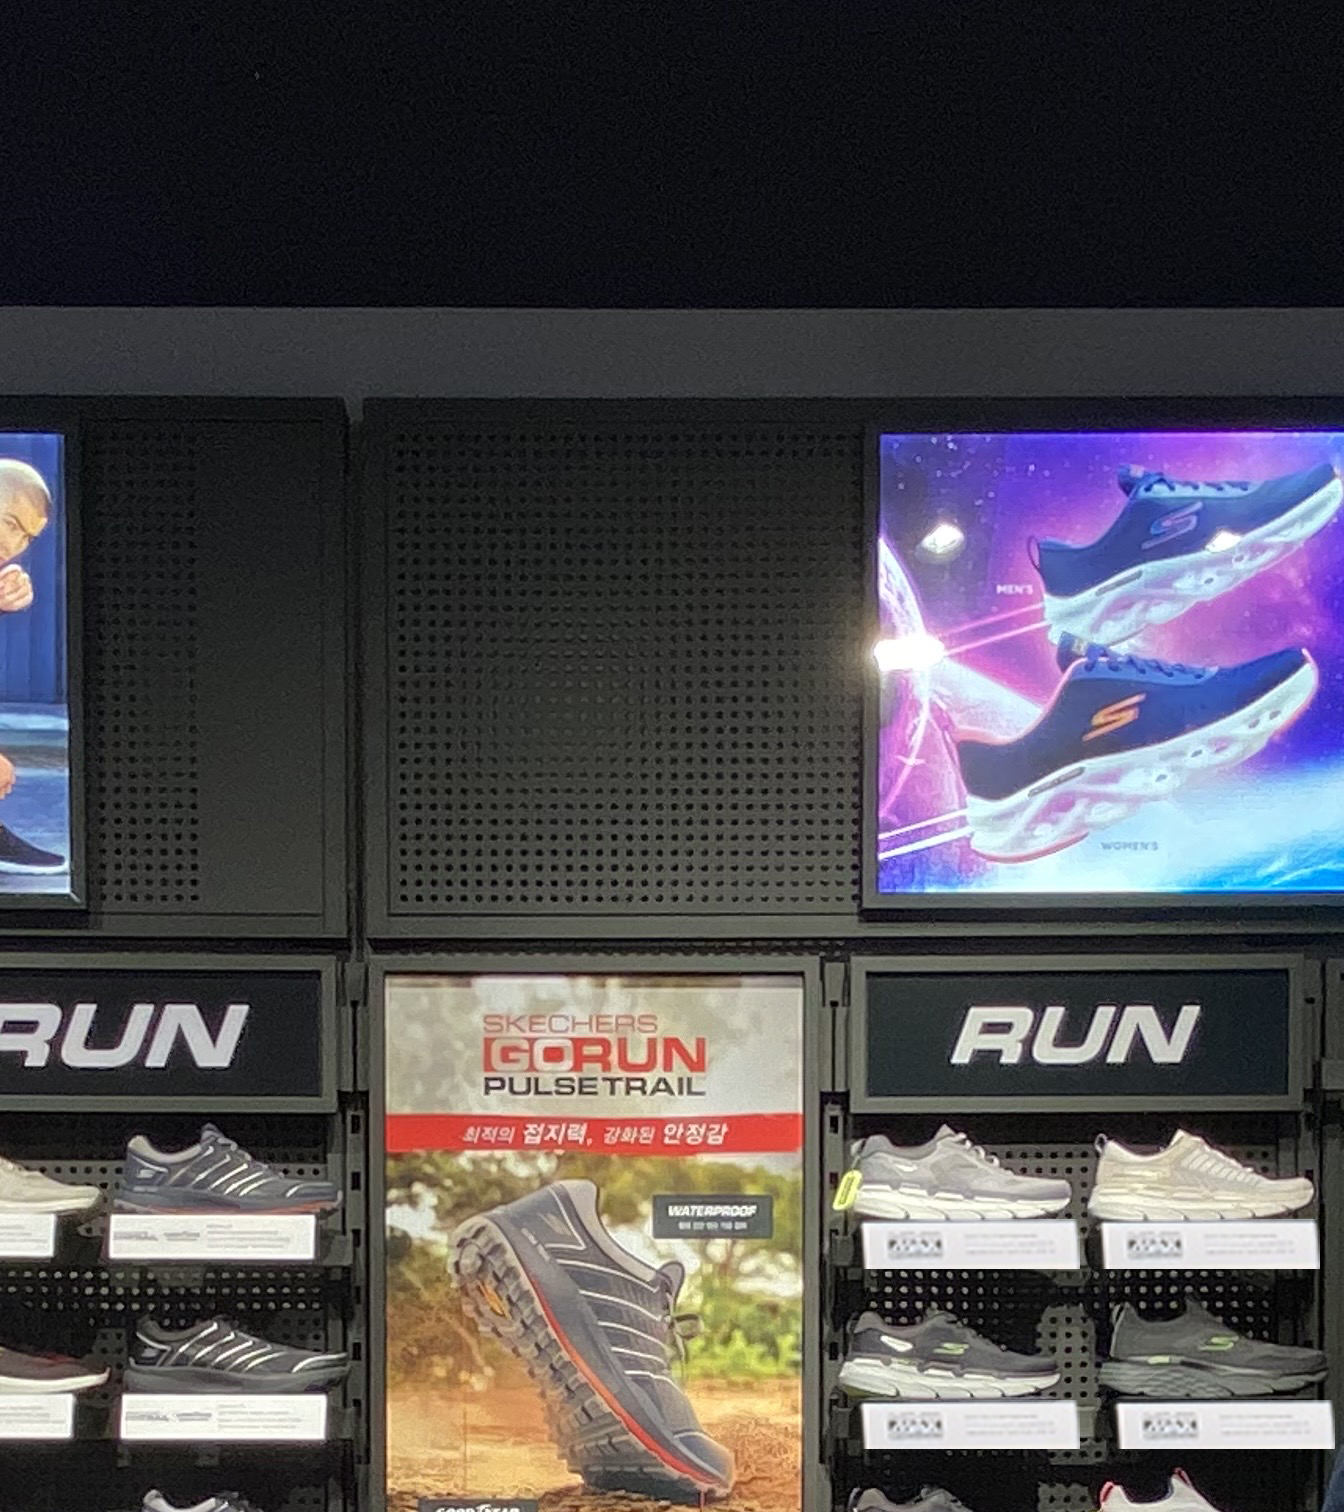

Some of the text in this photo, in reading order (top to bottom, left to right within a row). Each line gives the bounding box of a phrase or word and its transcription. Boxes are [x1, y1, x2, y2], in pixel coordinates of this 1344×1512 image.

[996, 584, 1034, 596] MEN'S
[1101, 841, 1159, 852] WOMEN'S
[483, 1014, 659, 1034] SKECHERS
[950, 1004, 1201, 1065] RUN
[482, 1036, 708, 1074] GORUN
[462, 1122, 730, 1147] 최적의 접지력, 강화된 안정감
[668, 1204, 758, 1217] WATERPROOF
